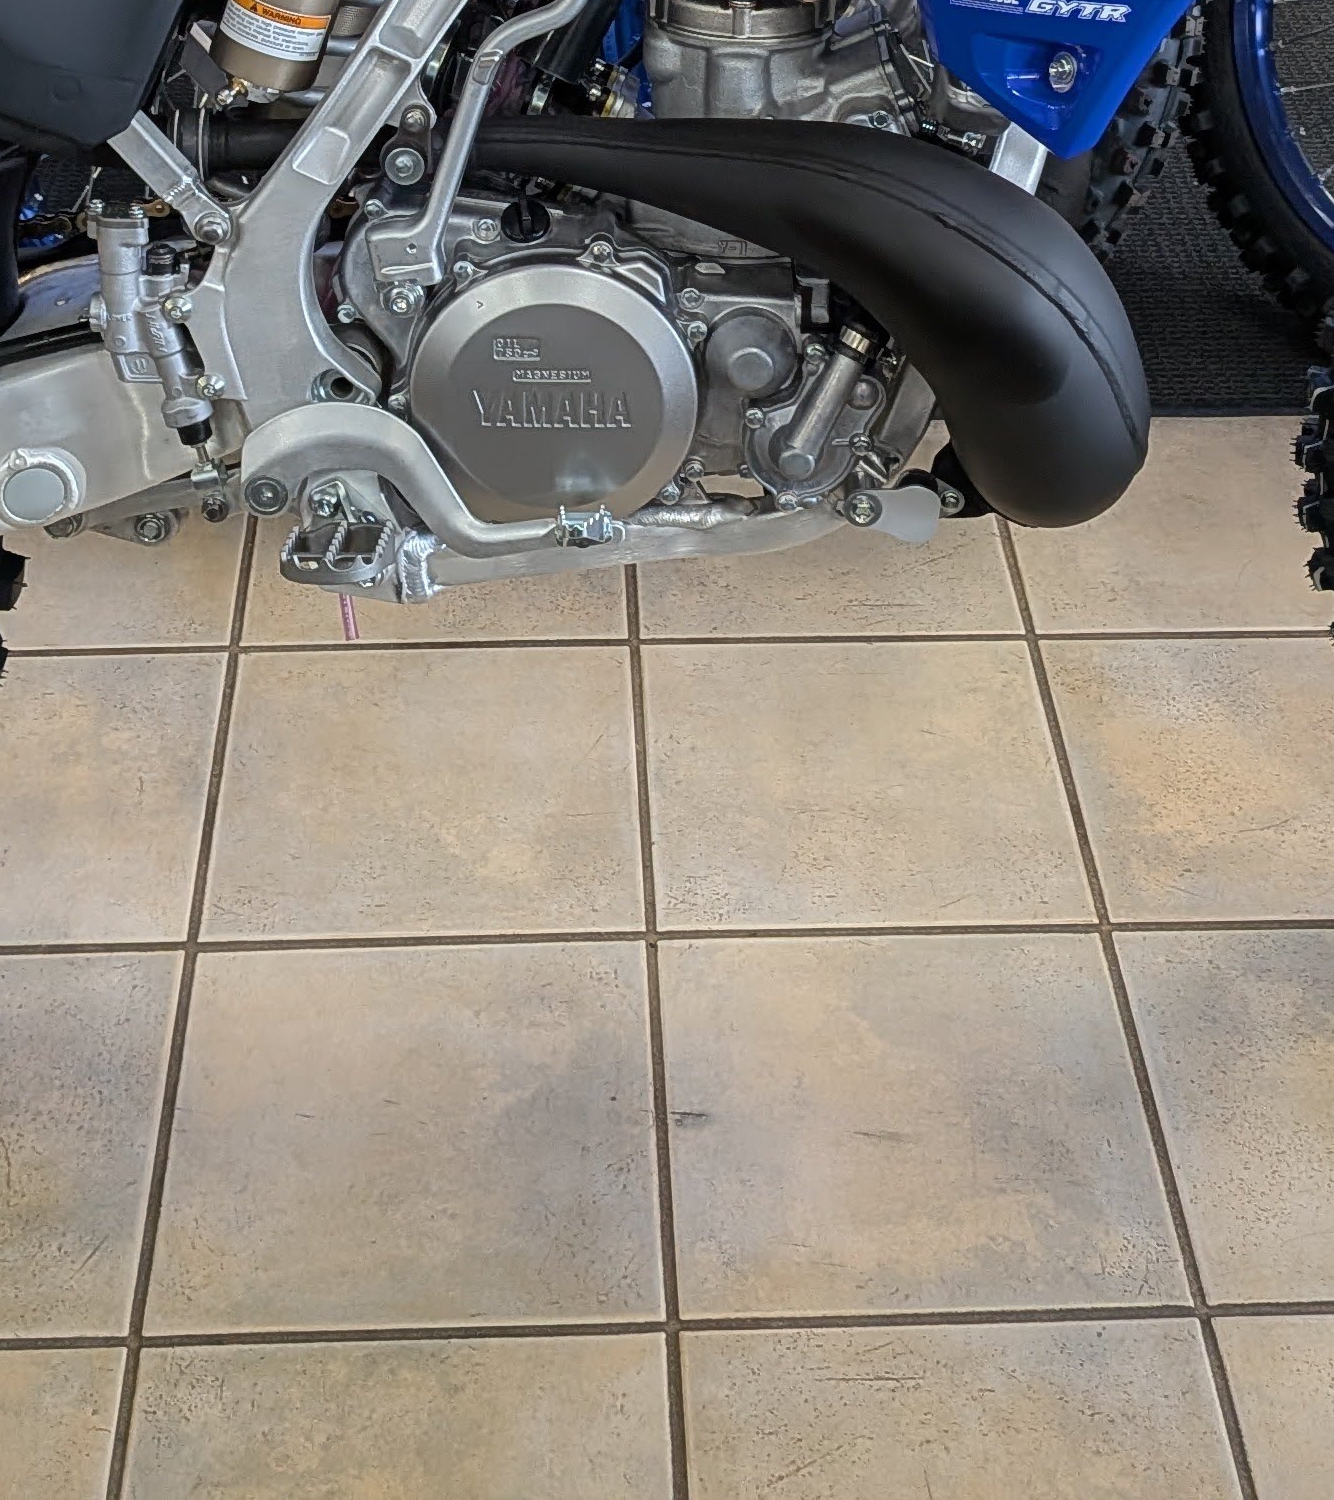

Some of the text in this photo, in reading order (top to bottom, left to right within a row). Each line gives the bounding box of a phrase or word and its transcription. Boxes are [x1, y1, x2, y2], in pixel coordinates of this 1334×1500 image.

[262, 8, 302, 25] WARNING
[514, 369, 591, 380] MAGNESIUM
[473, 389, 632, 428] YAMAHA
